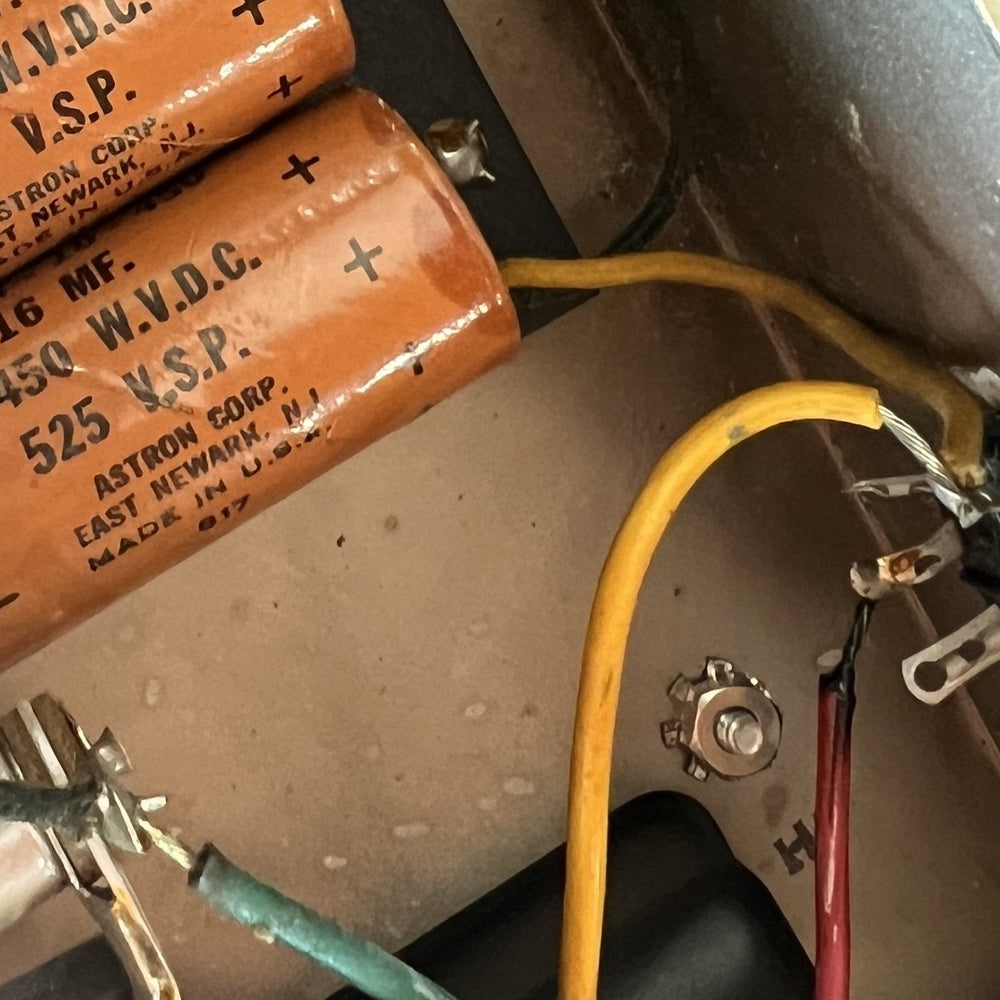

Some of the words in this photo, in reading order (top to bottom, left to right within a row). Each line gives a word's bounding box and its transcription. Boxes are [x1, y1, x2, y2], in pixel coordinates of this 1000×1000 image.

[10, 68, 137, 155] V.S.P.
[90, 116, 169, 166] CORP.
[30, 153, 146, 228] NEWARK,
[68, 200, 99, 226] IN
[58, 249, 136, 302] MF.
[85, 240, 263, 352] W.V.D.C.
[18, 395, 111, 476] 525
[121, 323, 253, 414] V.S.P.
[93, 421, 199, 501] ASTRON
[206, 375, 289, 430] CORP.
[73, 492, 138, 549] EAST
[149, 420, 271, 502] NEWARK,
[87, 505, 183, 572] MADE
[194, 478, 228, 508] IN
